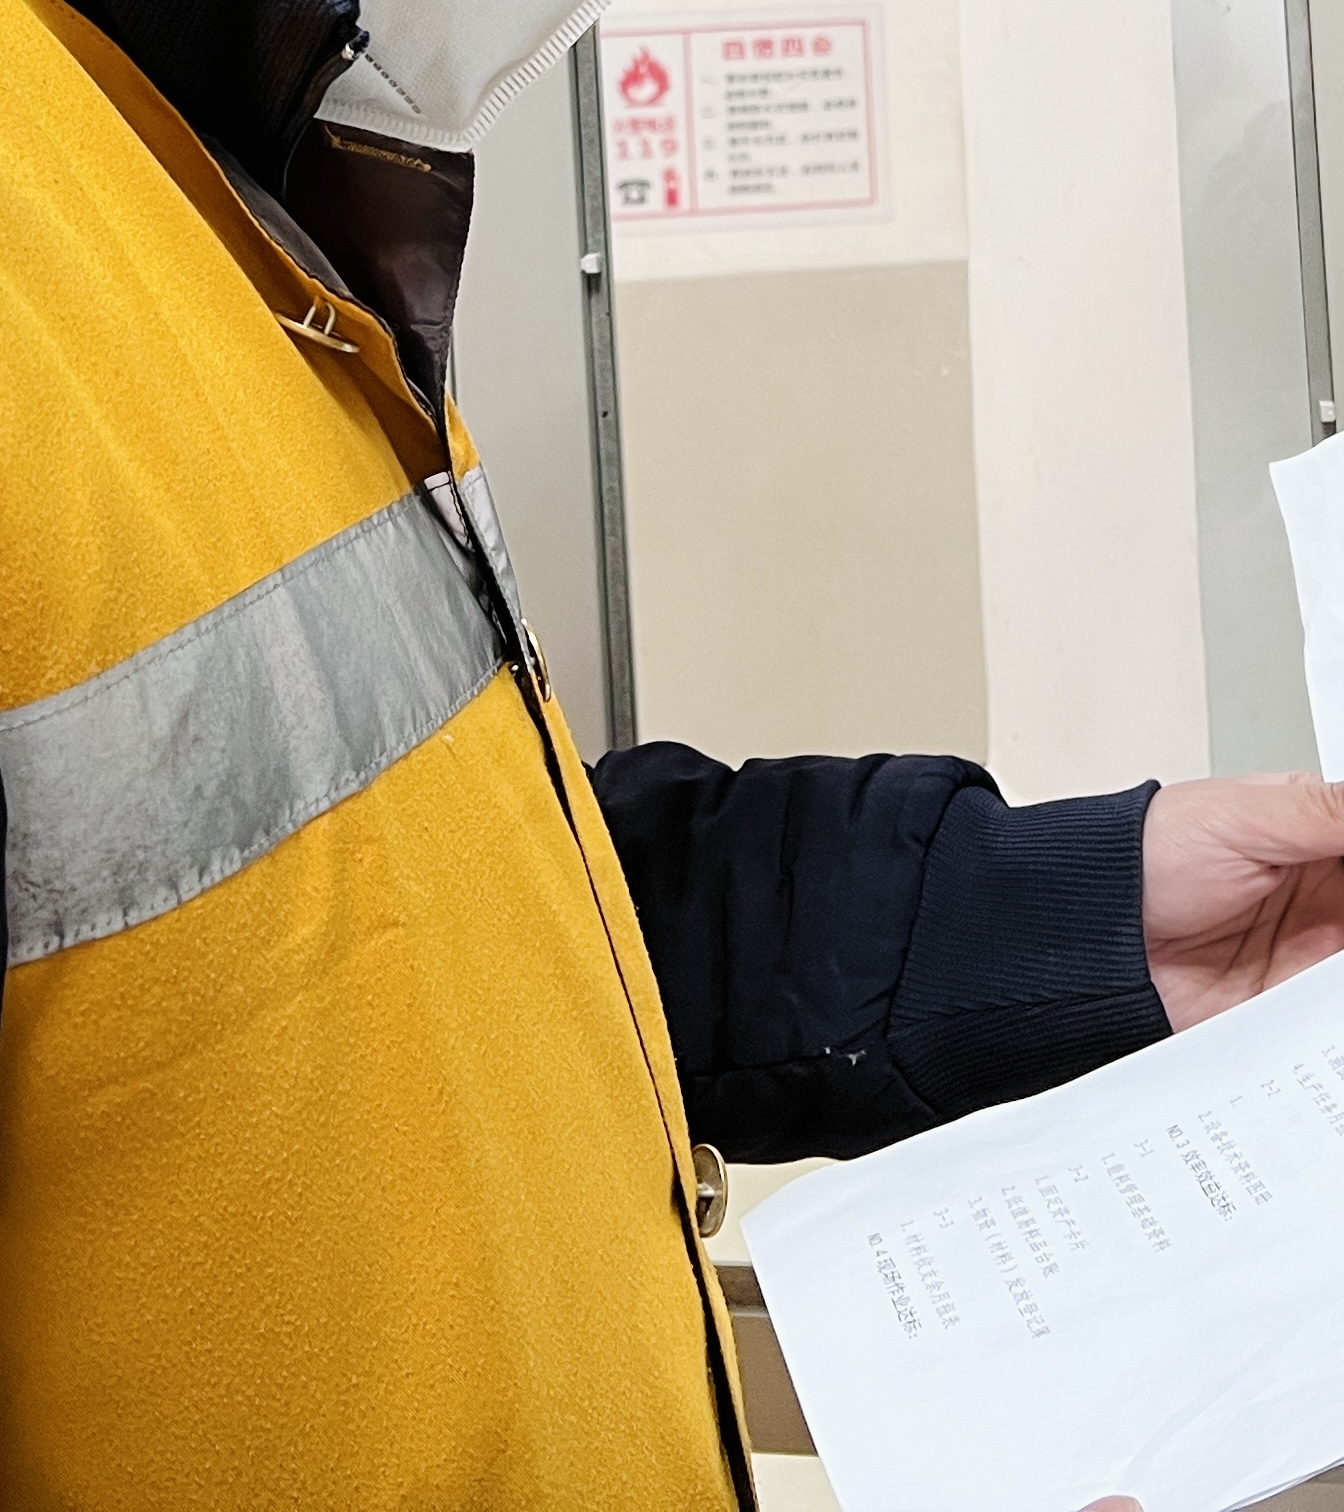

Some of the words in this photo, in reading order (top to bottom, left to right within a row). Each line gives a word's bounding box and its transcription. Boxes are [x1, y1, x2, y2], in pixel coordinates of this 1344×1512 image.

[616, 137, 679, 161] 119
[1259, 1078, 1281, 1098] 2-2
[1132, 1138, 1154, 1158] 3-1
[1066, 1163, 1089, 1183] 3-2
[932, 1207, 955, 1229] 3-3
